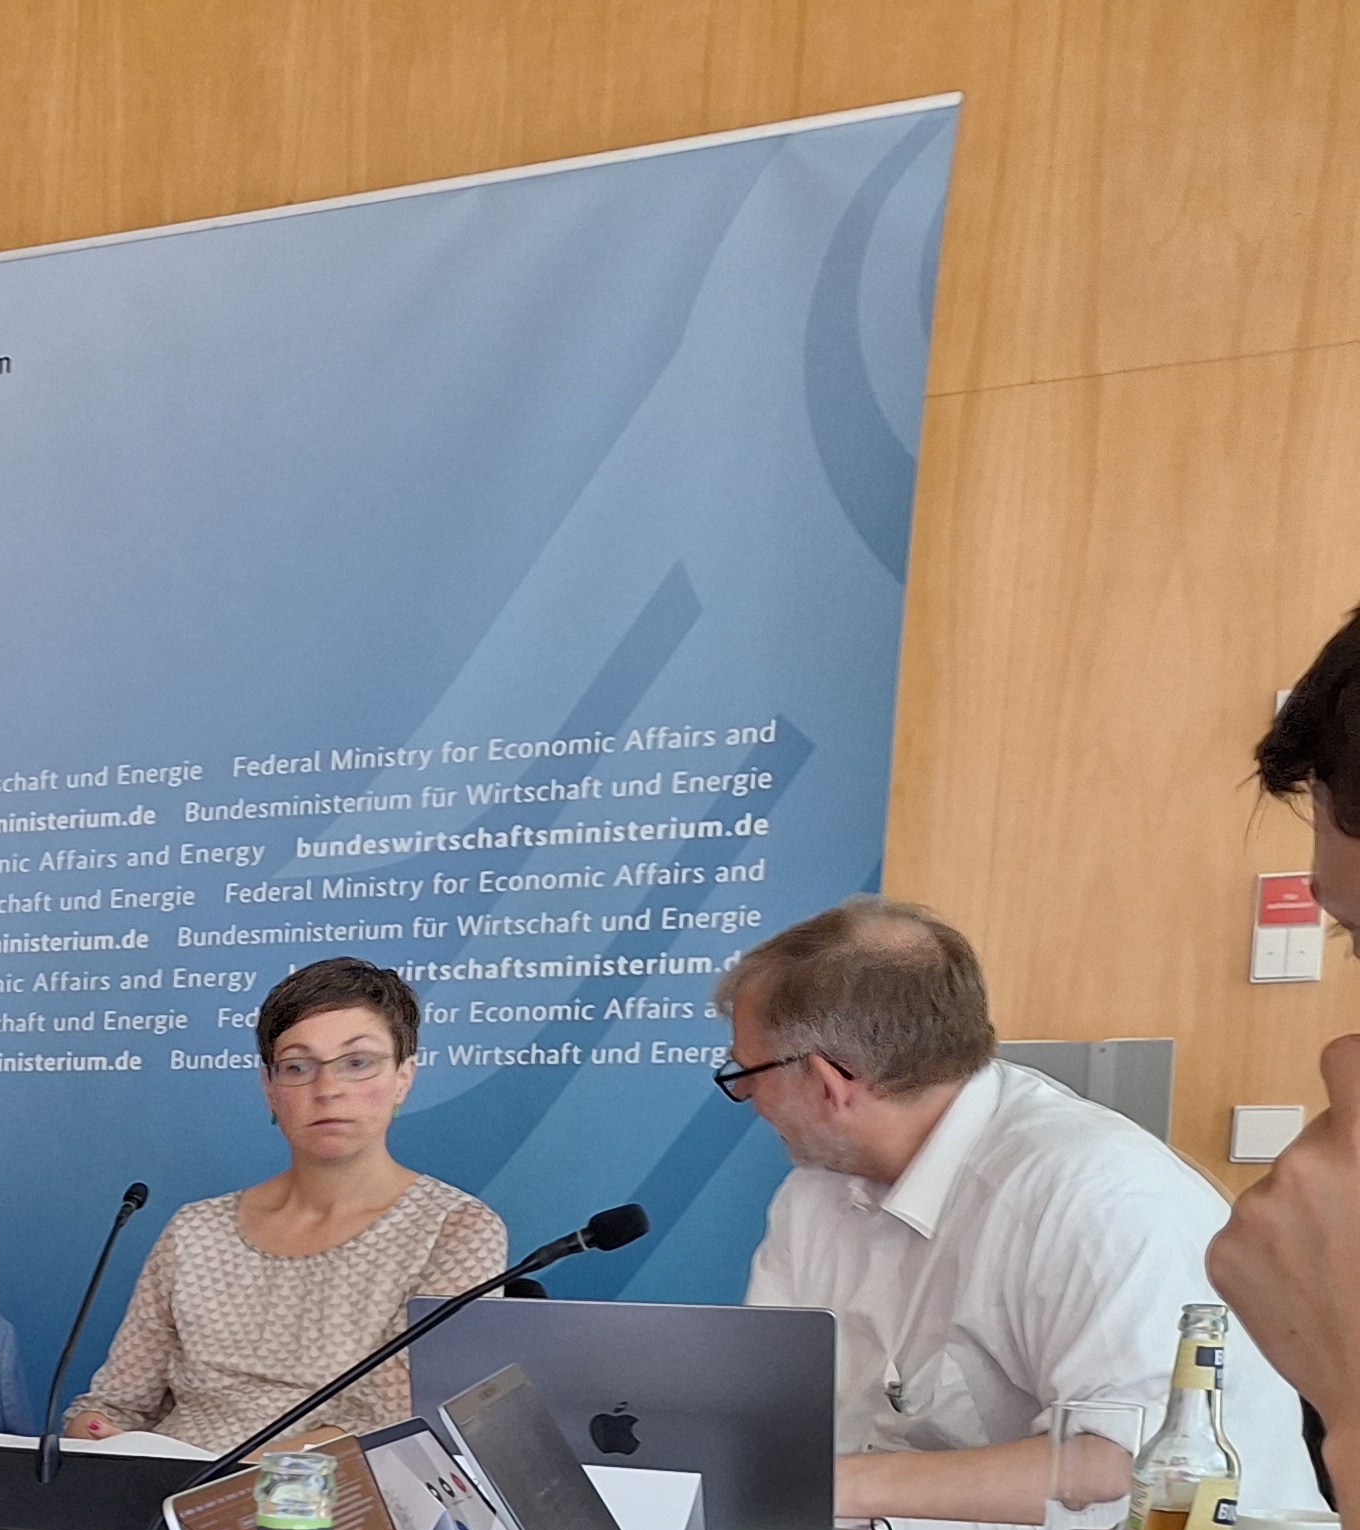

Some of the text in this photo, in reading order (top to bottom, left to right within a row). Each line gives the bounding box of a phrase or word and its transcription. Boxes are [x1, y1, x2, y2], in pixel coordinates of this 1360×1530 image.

[67, 768, 108, 789] und
[117, 761, 203, 786] Energie
[233, 751, 321, 778] Federal
[330, 744, 433, 772] Ministry
[442, 741, 479, 765] for
[488, 731, 616, 761] Economic
[624, 724, 717, 752] Affairs
[725, 720, 777, 746] and
[185, 790, 412, 823] Bundesministerium
[421, 786, 457, 809] für
[466, 776, 603, 806] Wirtschaft
[612, 773, 662, 797] und
[672, 768, 773, 796] Energie
[39, 848, 118, 872] Affairs
[127, 845, 169, 867] and
[180, 843, 265, 867] Energy
[296, 813, 770, 858] bundeswirtschaftsministerium.de
[60, 889, 101, 910] und
[110, 887, 195, 909] Energie
[224, 880, 313, 903] Federal
[322, 874, 424, 902] Ministry
[433, 872, 470, 895] for
[479, 866, 606, 892] Economic
[613, 860, 705, 887] Affairs
[715, 858, 765, 883] and
[178, 919, 403, 947] Bundesministerium
[412, 918, 448, 939] für
[457, 911, 592, 936] Wirtschaft
[601, 908, 651, 933] und
[661, 905, 762, 931] Energie
[33, 969, 111, 993] Affairs
[119, 968, 163, 990] and
[173, 967, 257, 991] Energy
[53, 1010, 96, 1032] und
[103, 1008, 188, 1034] Energie
[424, 1001, 460, 1023] for
[469, 999, 595, 1023] Economic
[603, 996, 695, 1021] Affairs
[417, 1046, 439, 1066] ür
[448, 1044, 582, 1067] Wirtschaft
[590, 1043, 641, 1064] und
[651, 1041, 733, 1068] Energ
